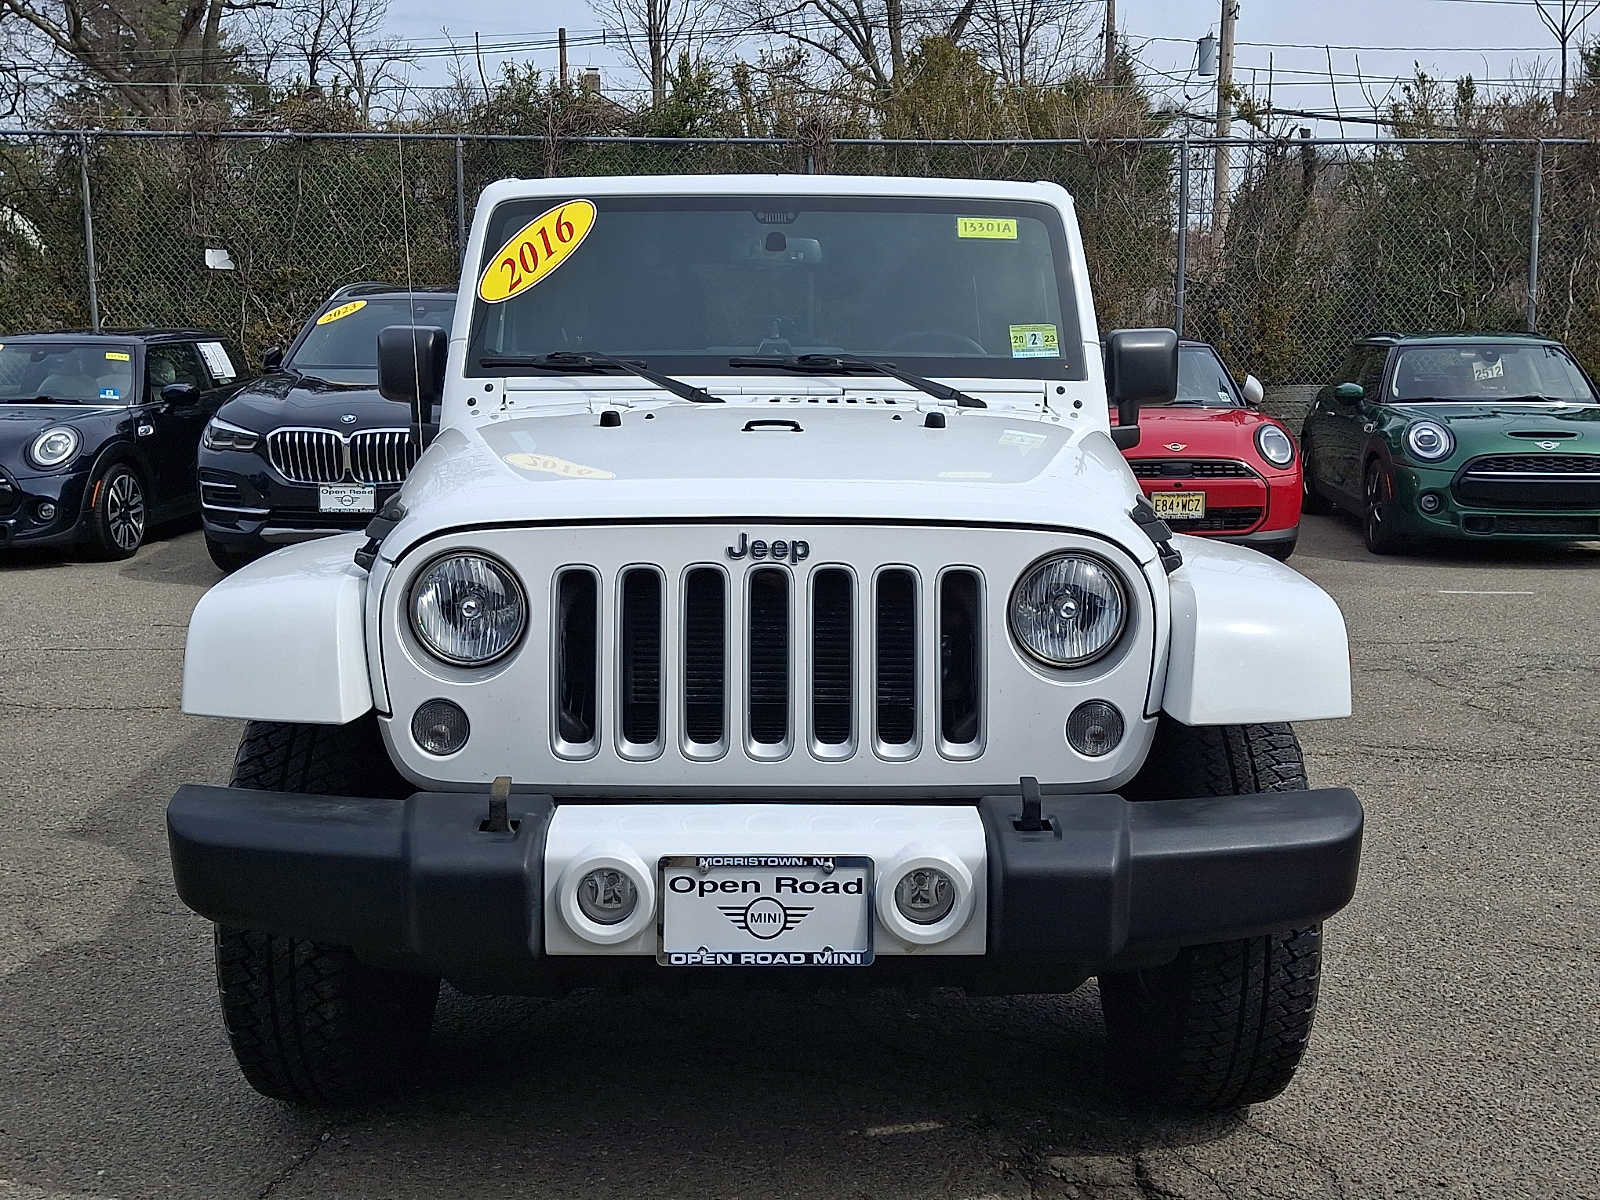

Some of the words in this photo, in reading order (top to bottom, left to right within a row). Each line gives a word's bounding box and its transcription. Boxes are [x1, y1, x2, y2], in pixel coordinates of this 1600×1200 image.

[963, 221, 1012, 233] 13301A
[500, 207, 575, 293] 2016
[1013, 335, 1024, 344] 20
[1031, 333, 1038, 346] 2
[1044, 335, 1056, 343] 23
[727, 532, 810, 565] Jeep
[668, 876, 761, 897] Open
[775, 877, 864, 895] Road
[750, 912, 782, 924] MINI
[670, 953, 733, 965] OPEN
[740, 953, 805, 965] ROAD
[813, 952, 862, 965] MINI
